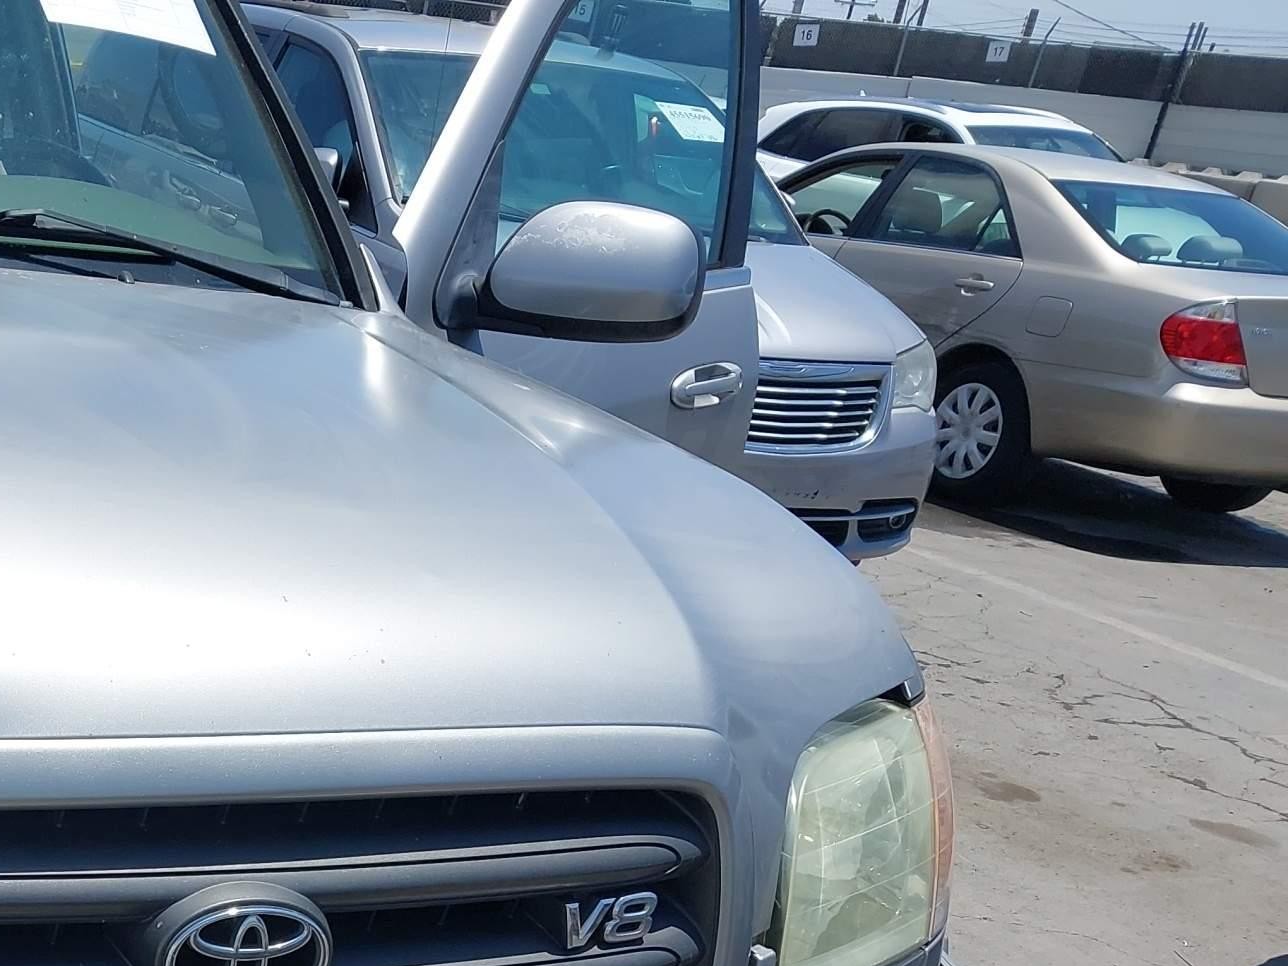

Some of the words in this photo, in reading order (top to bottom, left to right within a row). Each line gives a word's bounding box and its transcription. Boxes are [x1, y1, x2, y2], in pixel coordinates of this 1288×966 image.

[801, 29, 813, 41] 16
[993, 46, 1005, 57] 17
[565, 891, 658, 950] V8
